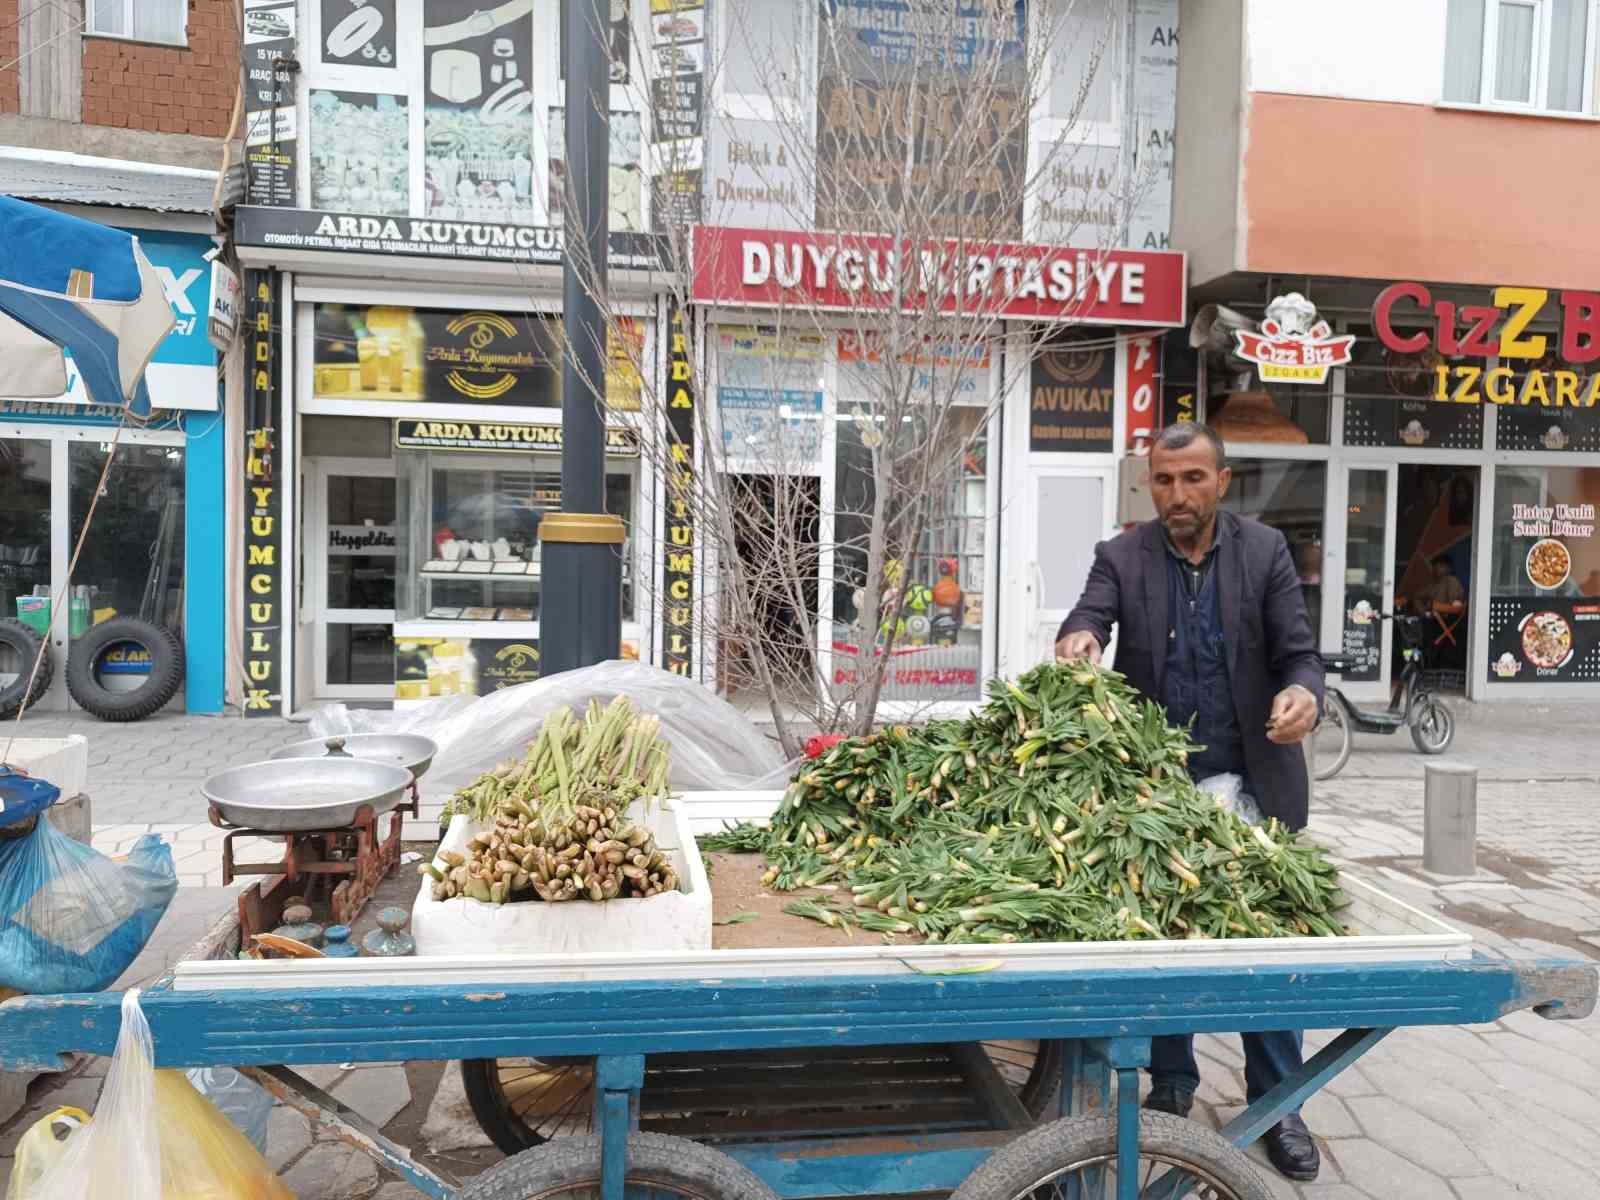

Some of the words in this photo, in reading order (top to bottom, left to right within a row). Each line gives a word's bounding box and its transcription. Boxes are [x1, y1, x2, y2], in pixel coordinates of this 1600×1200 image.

[315, 215, 402, 240] ARDA
[742, 240, 896, 293] DUYGU
[1033, 386, 1114, 412] AVUKAT
[414, 422, 474, 440] ARDA
